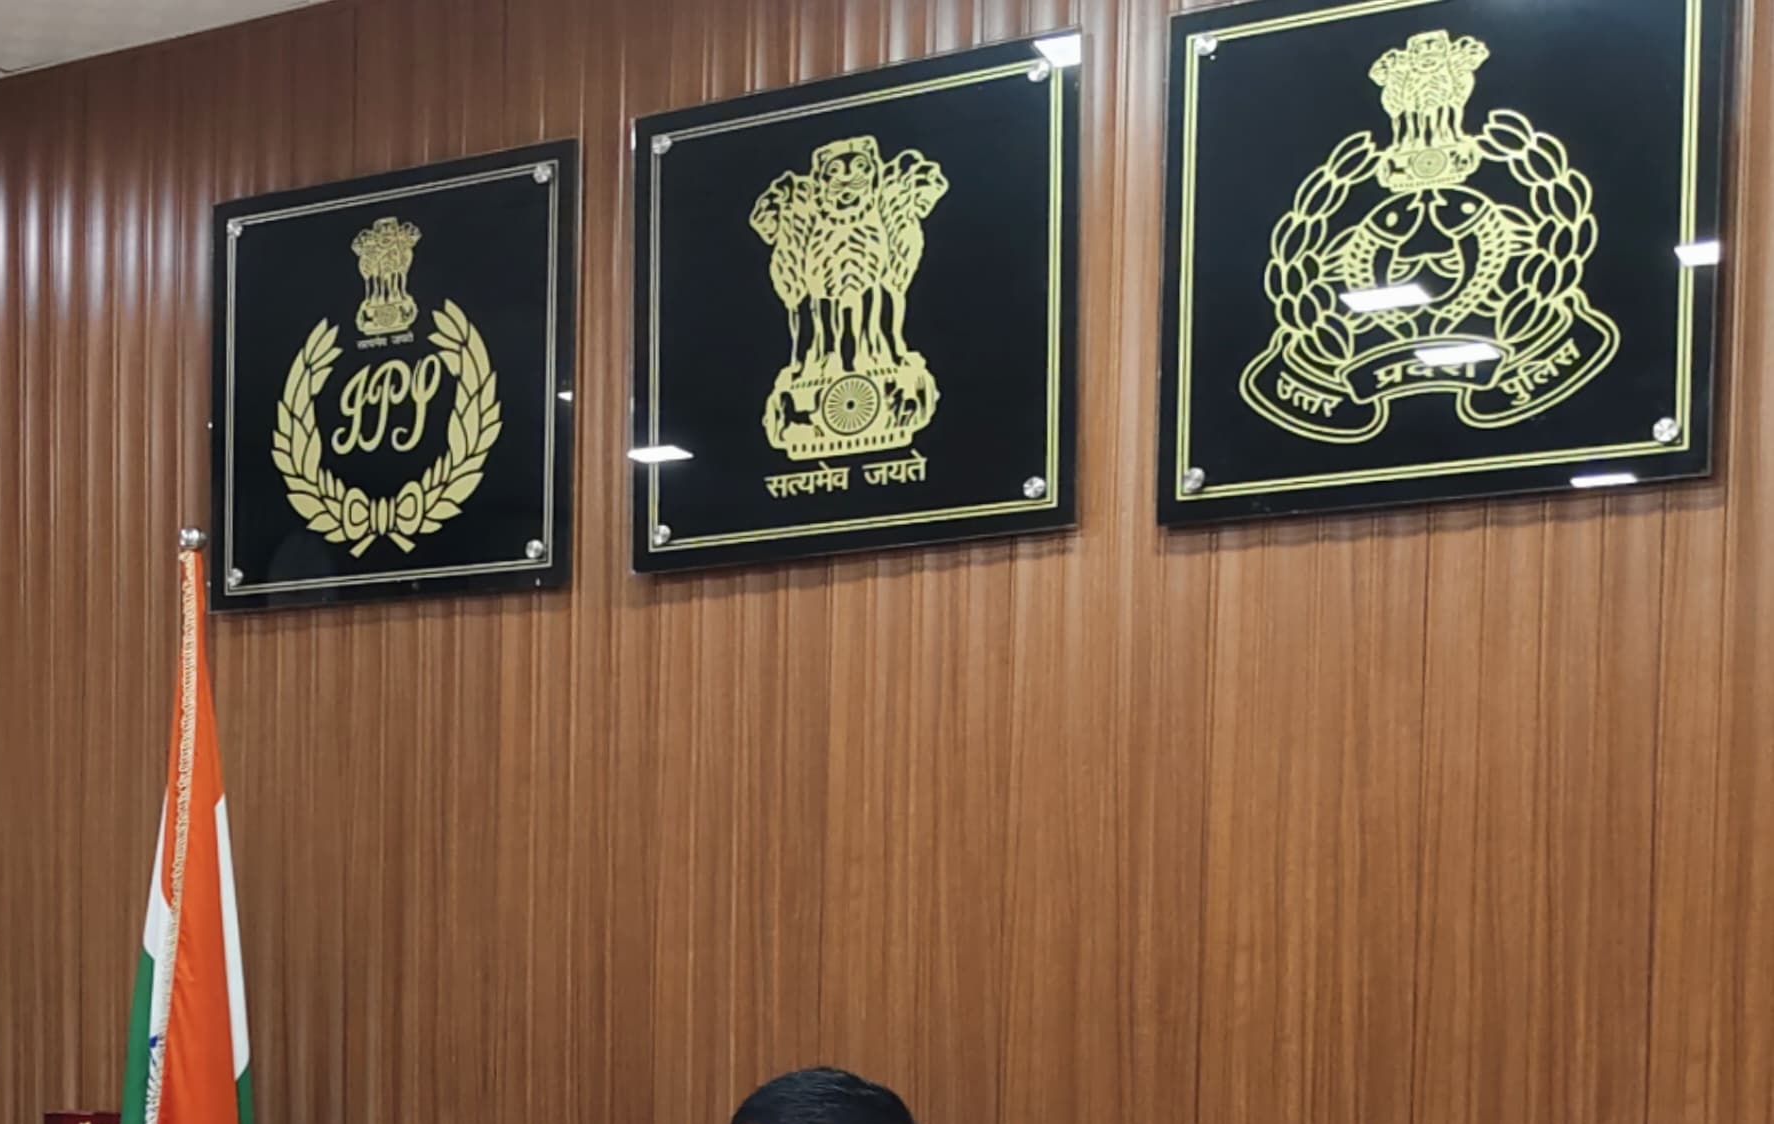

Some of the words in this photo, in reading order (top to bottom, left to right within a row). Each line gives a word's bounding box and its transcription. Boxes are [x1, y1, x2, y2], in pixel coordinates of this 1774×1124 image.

[1276, 370, 1344, 418] उत्तर
[1498, 338, 1581, 406] पुलिस
[763, 460, 851, 499] सत्यमेव
[861, 448, 929, 486] जयते
